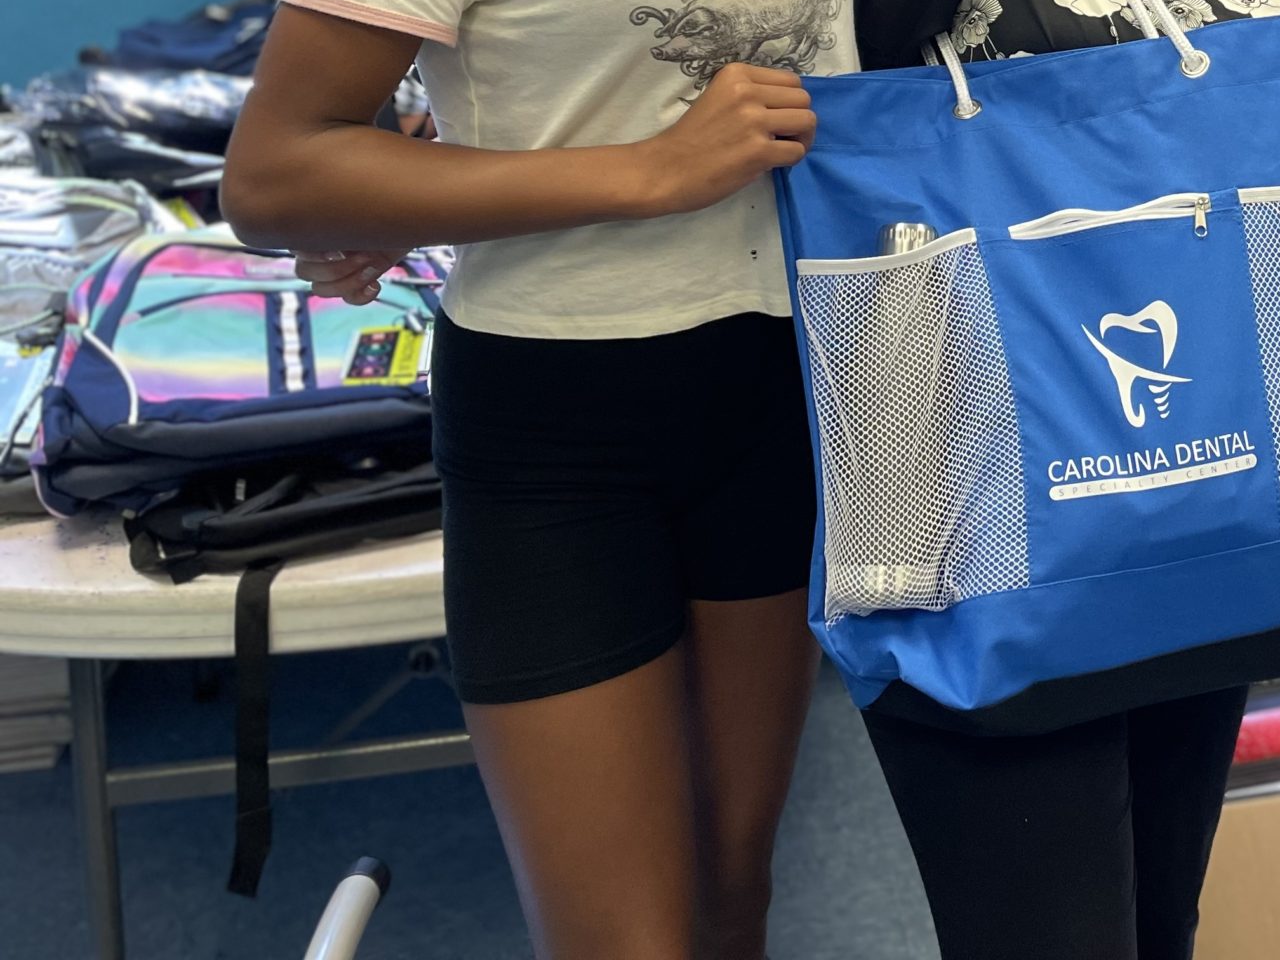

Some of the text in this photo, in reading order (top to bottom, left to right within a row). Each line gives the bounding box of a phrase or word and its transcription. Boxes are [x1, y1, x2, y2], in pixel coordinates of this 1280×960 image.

[1047, 430, 1256, 483] CAROLINA DENTAL
[1058, 458, 1252, 498] SPECIALTY CENTER
